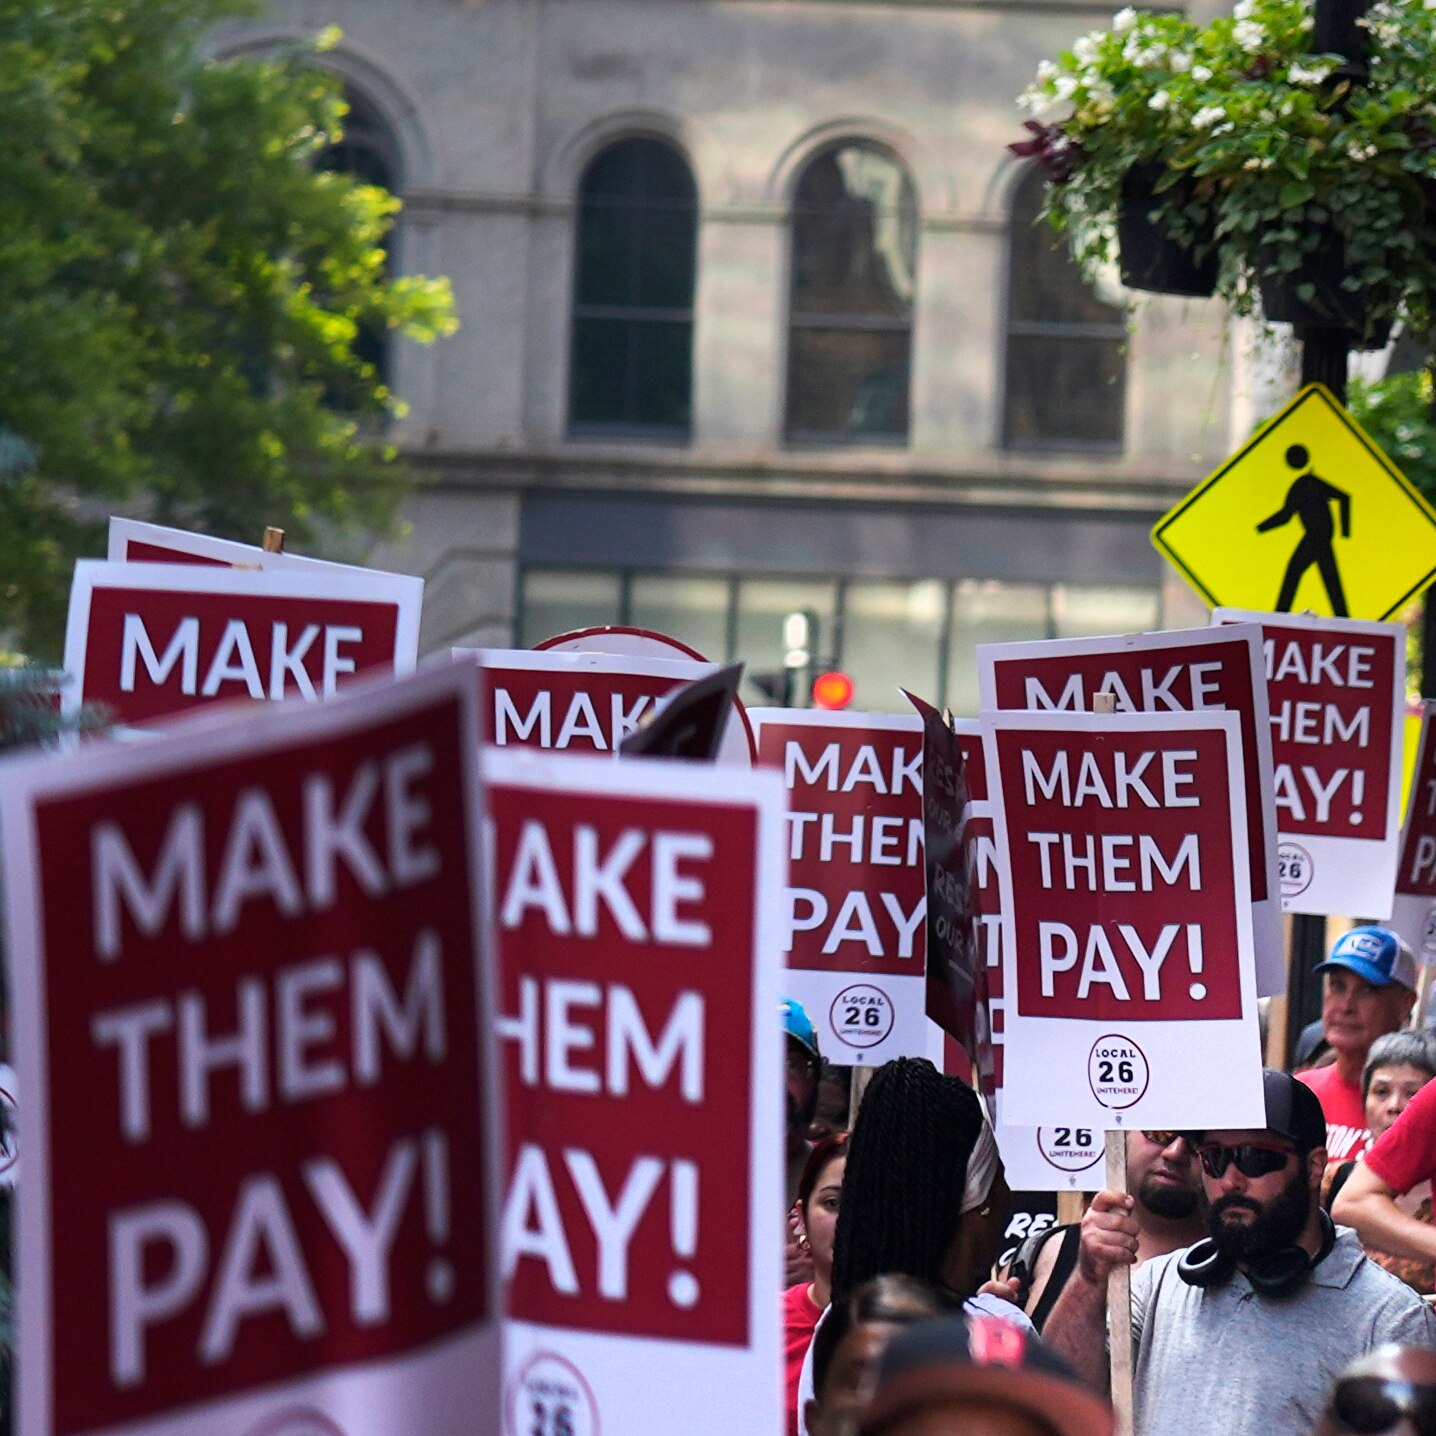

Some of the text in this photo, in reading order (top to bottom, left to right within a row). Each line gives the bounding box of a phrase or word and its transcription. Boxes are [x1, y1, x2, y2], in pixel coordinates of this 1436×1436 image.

[120, 613, 363, 701] MAKE
[495, 688, 672, 752] MAK
[1269, 700, 1370, 748] HEM
[785, 740, 925, 796] MAK
[1021, 749, 1201, 809] MAKE
[1274, 763, 1365, 825] AY!
[91, 742, 441, 964] MAKE
[482, 817, 715, 948] AKE
[1027, 832, 1202, 892] THEM
[785, 887, 927, 959] PAY
[1037, 922, 1207, 1001] PAY!
[92, 930, 448, 1142] THEM
[496, 974, 705, 1104] HEM
[844, 1006, 880, 1027] 26
[1095, 1048, 1136, 1059] LOCAL
[1098, 1060, 1134, 1083] 26
[1053, 1126, 1093, 1147] 26
[501, 1141, 702, 1308] AY!
[108, 1130, 454, 1388] PAY!
